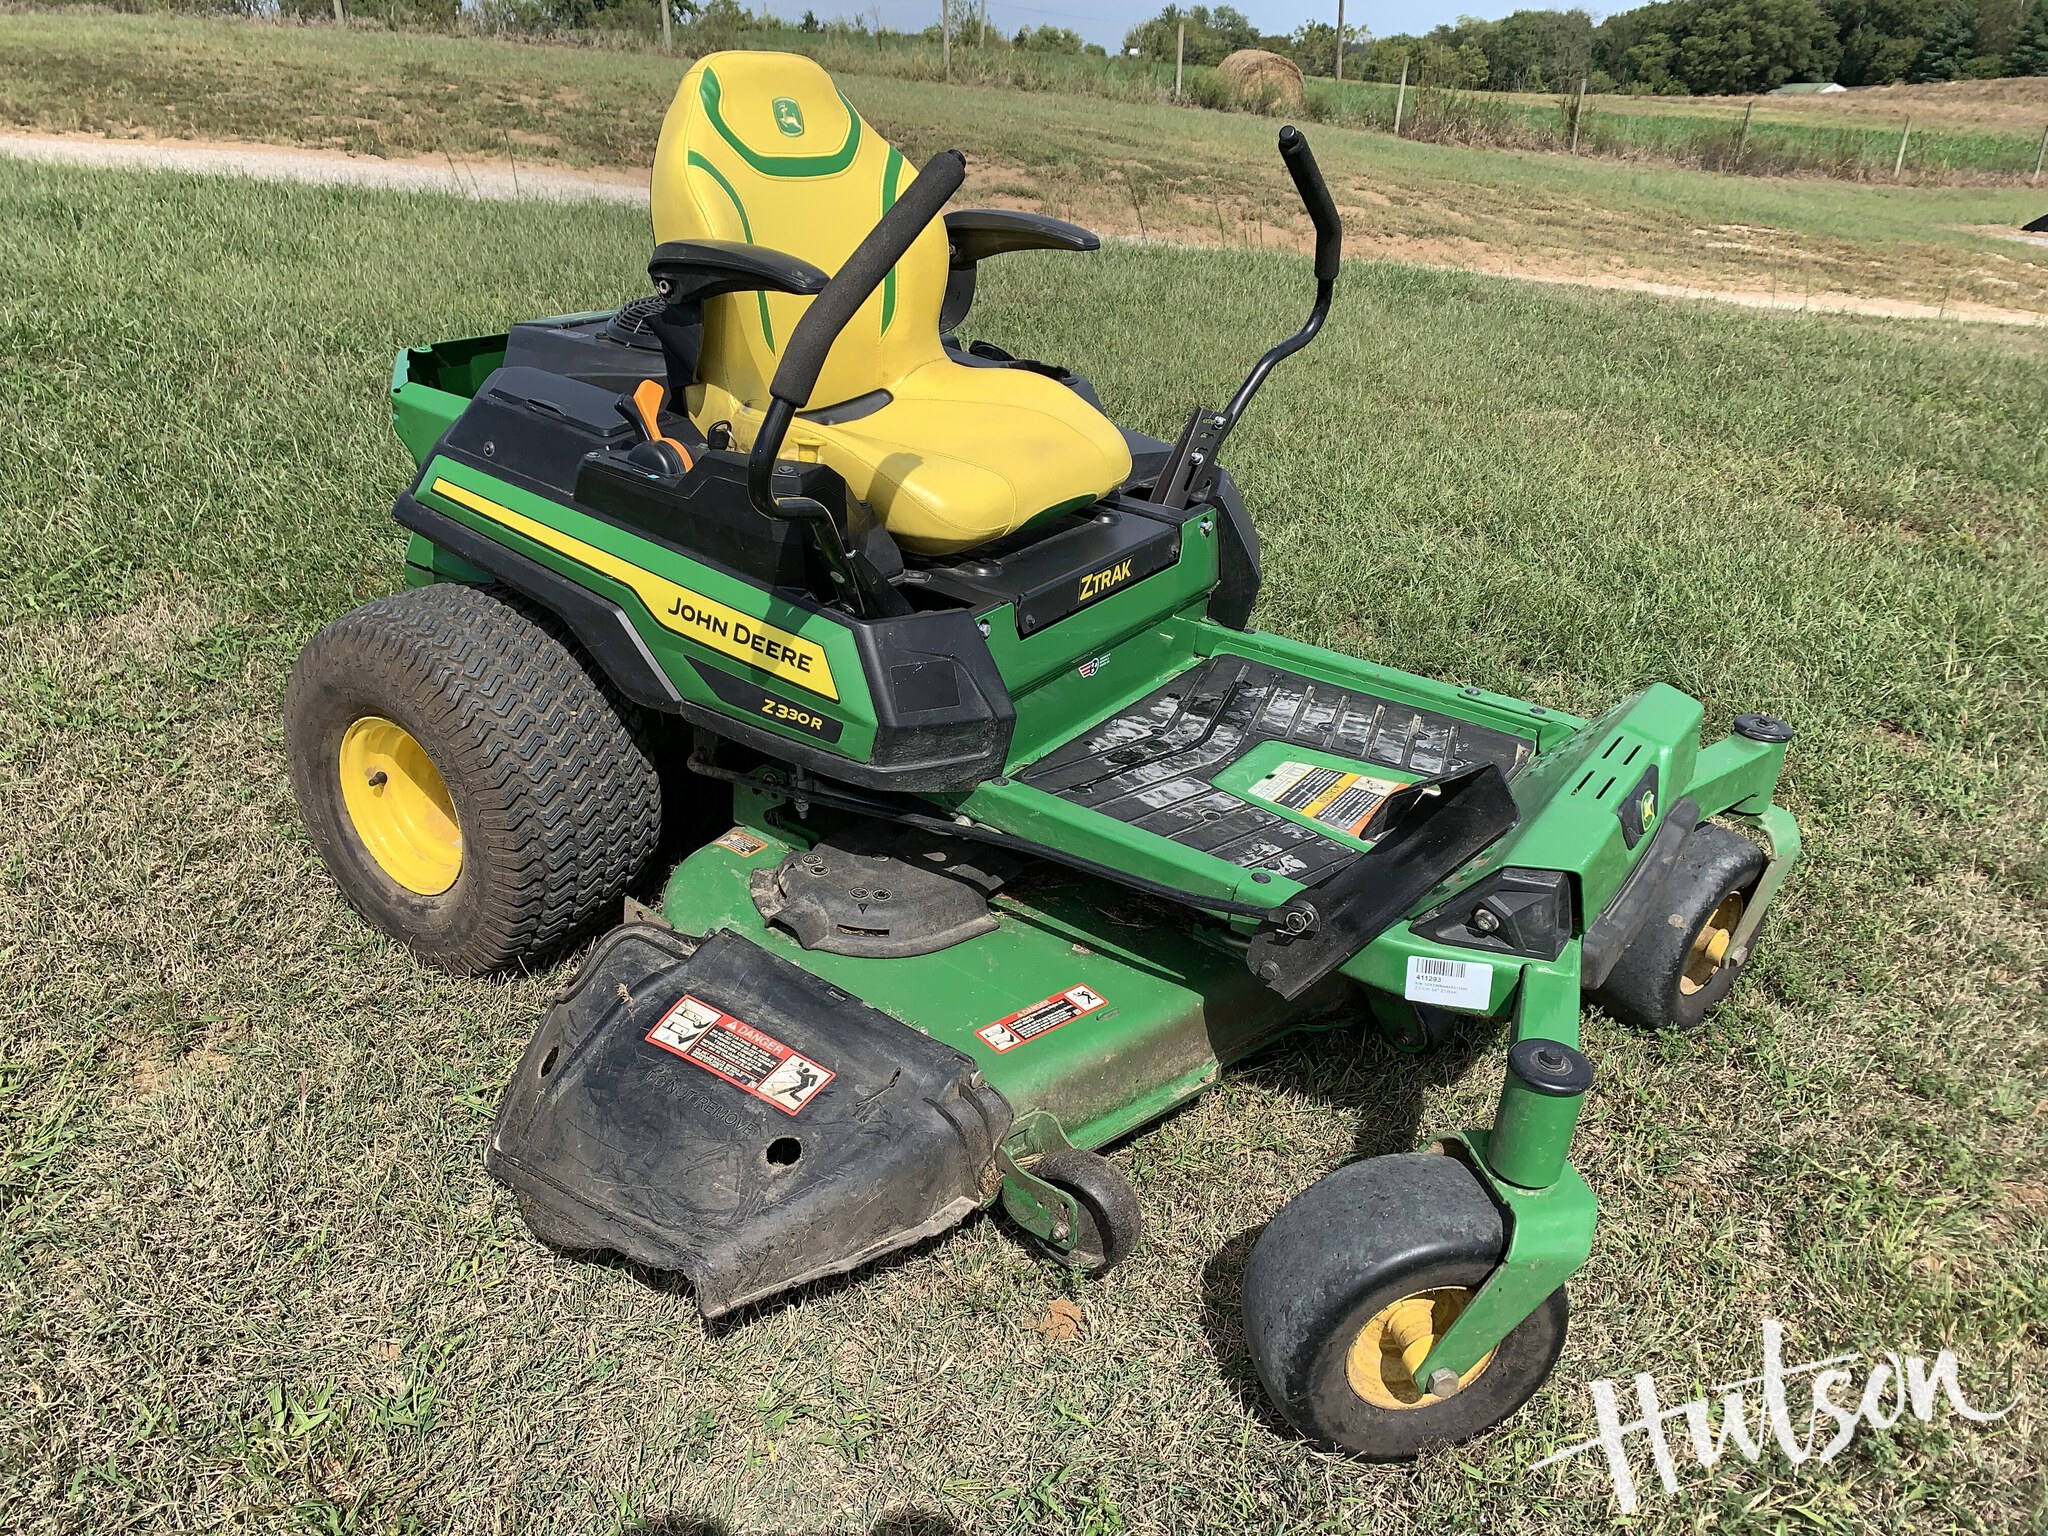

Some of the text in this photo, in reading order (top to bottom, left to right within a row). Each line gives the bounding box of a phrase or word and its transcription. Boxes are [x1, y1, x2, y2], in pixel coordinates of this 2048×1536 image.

[1079, 558, 1132, 601] ZTRAK
[667, 597, 813, 673] JOHN DEERE
[761, 698, 823, 730] Z330R
[1415, 974, 1442, 983] 411293
[1023, 999, 1051, 1017] DANGER
[737, 1025, 784, 1055] DANGER
[694, 1096, 757, 1137] REMOVE
